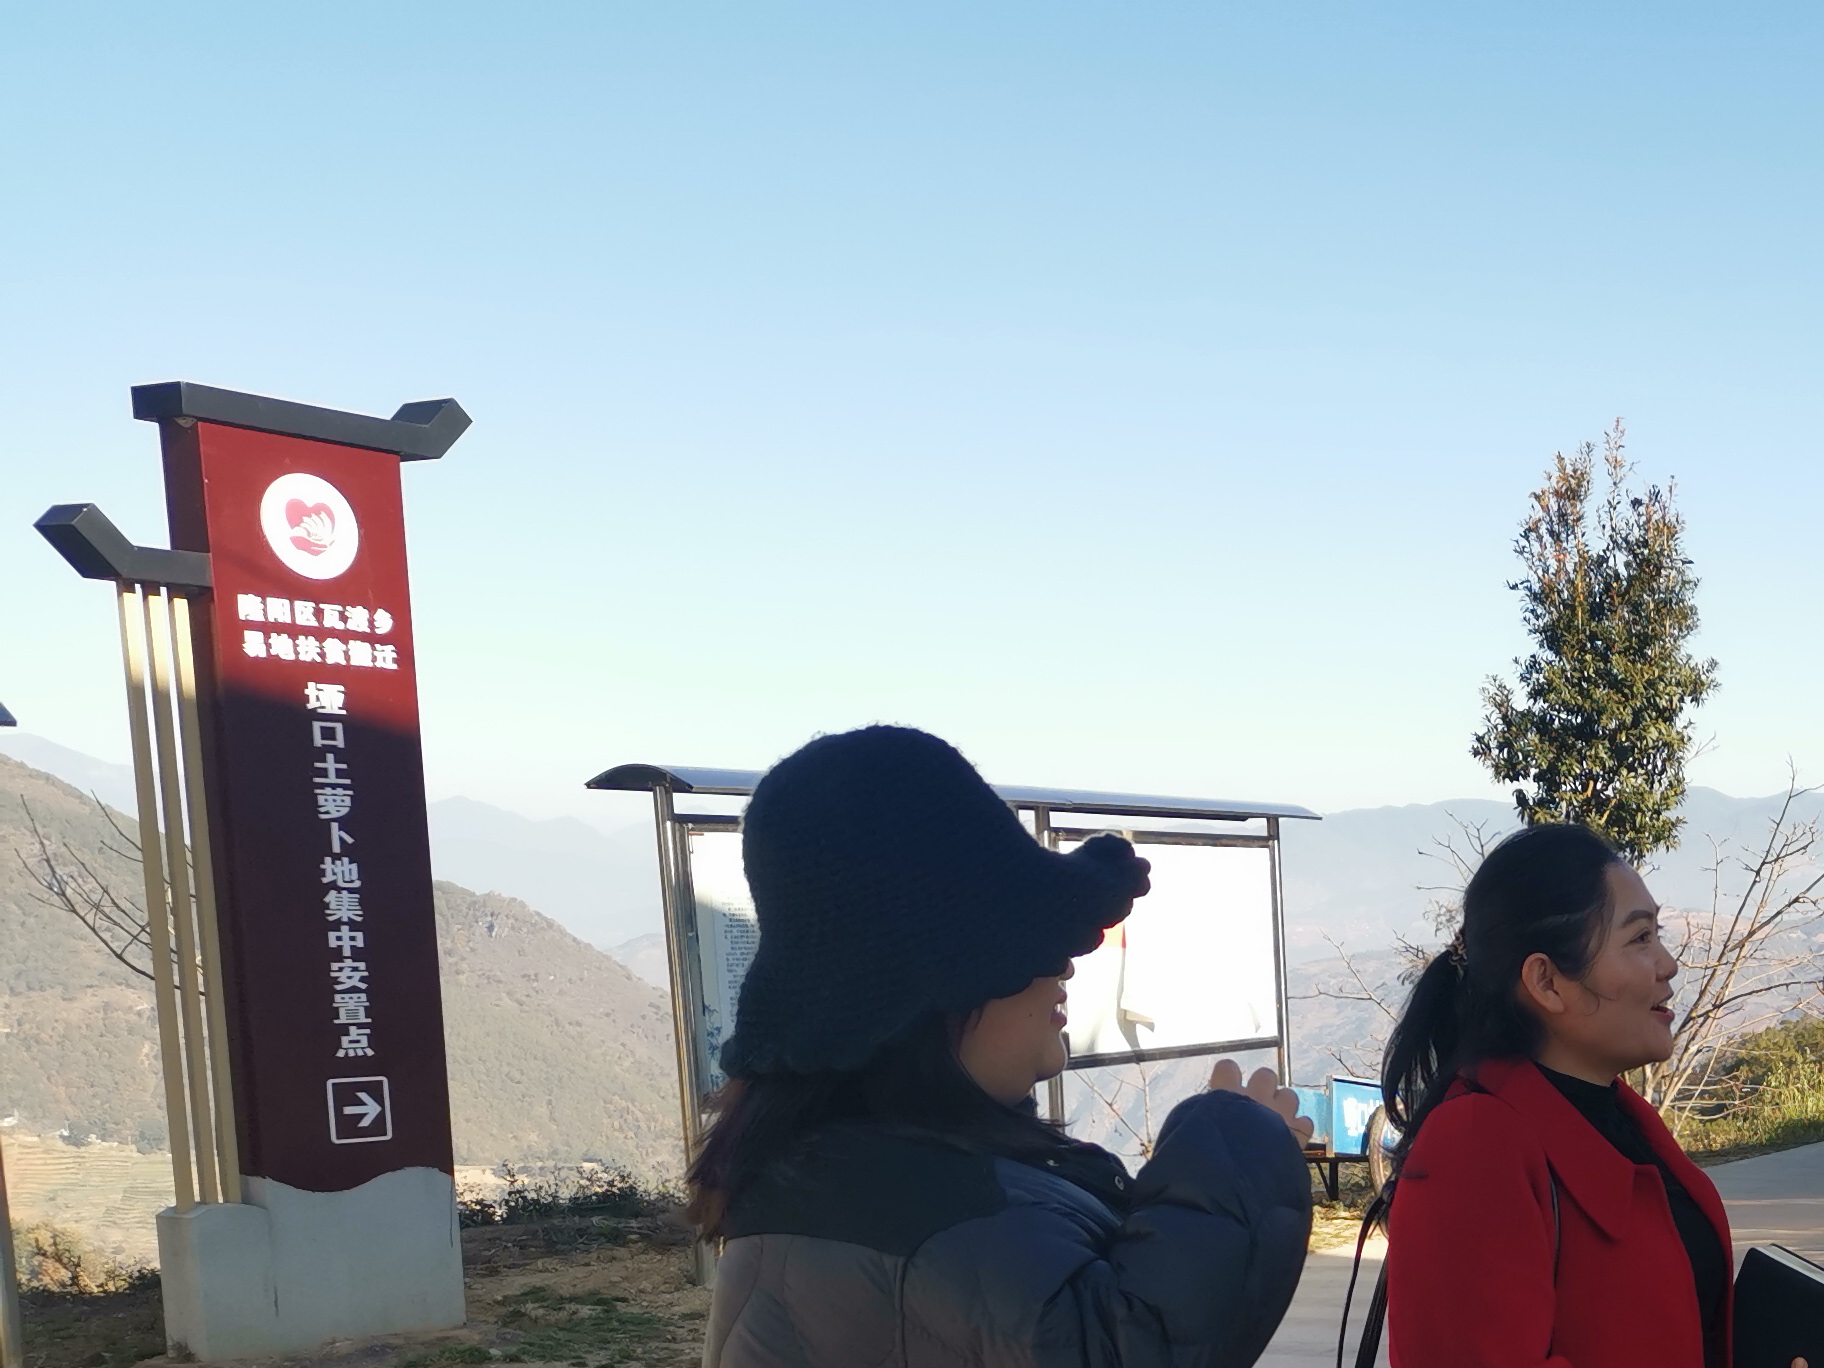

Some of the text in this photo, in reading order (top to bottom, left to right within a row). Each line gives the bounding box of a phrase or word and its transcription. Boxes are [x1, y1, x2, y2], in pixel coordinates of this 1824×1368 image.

[304, 681, 376, 1058] 垭口土萝卜地集中安置点
